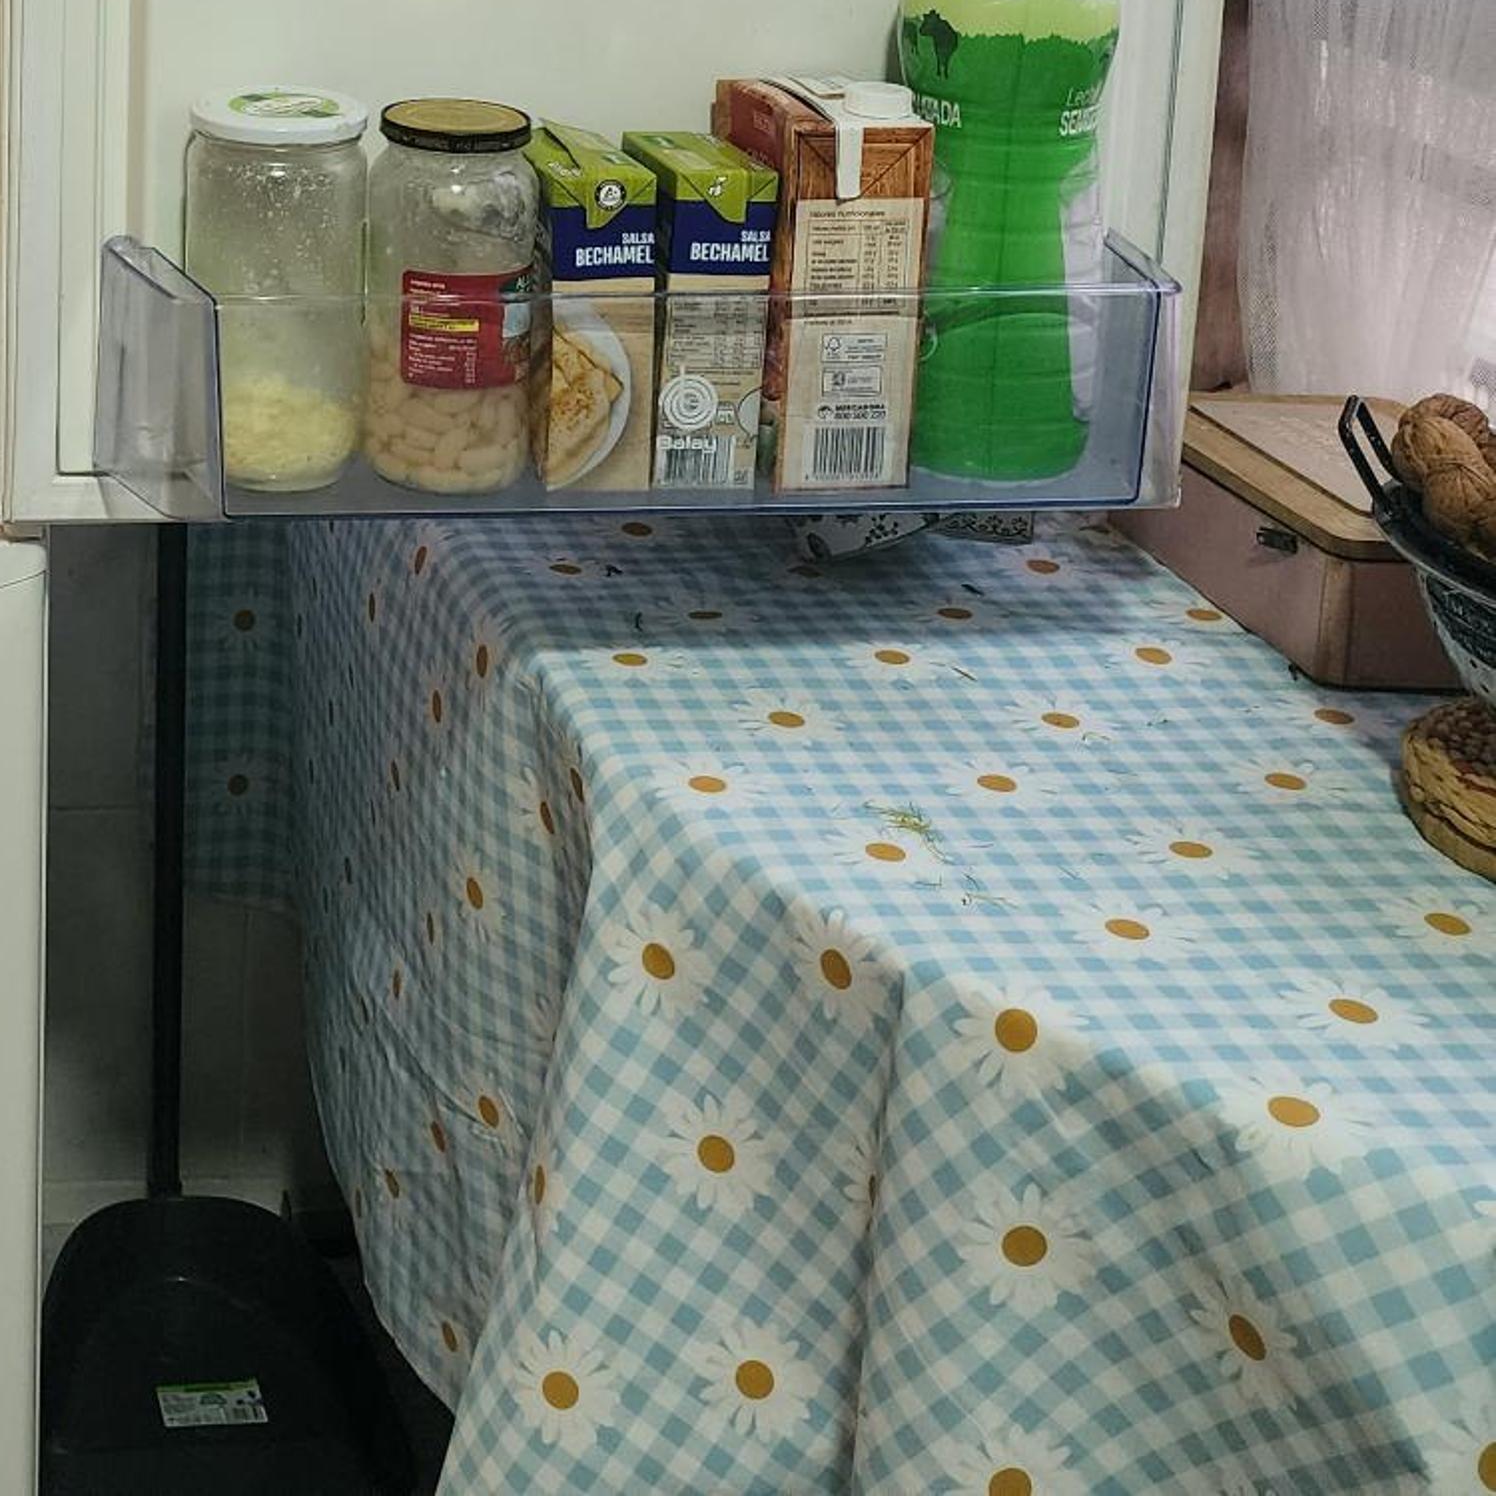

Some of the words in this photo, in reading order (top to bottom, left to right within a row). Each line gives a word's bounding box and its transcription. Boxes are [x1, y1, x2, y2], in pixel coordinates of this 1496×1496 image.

[621, 232, 654, 244] SALSA
[740, 230, 771, 243] SALSA
[575, 246, 655, 267] BECHAMEL
[689, 242, 770, 263] BECHAMEL
[658, 435, 717, 454] Balay
